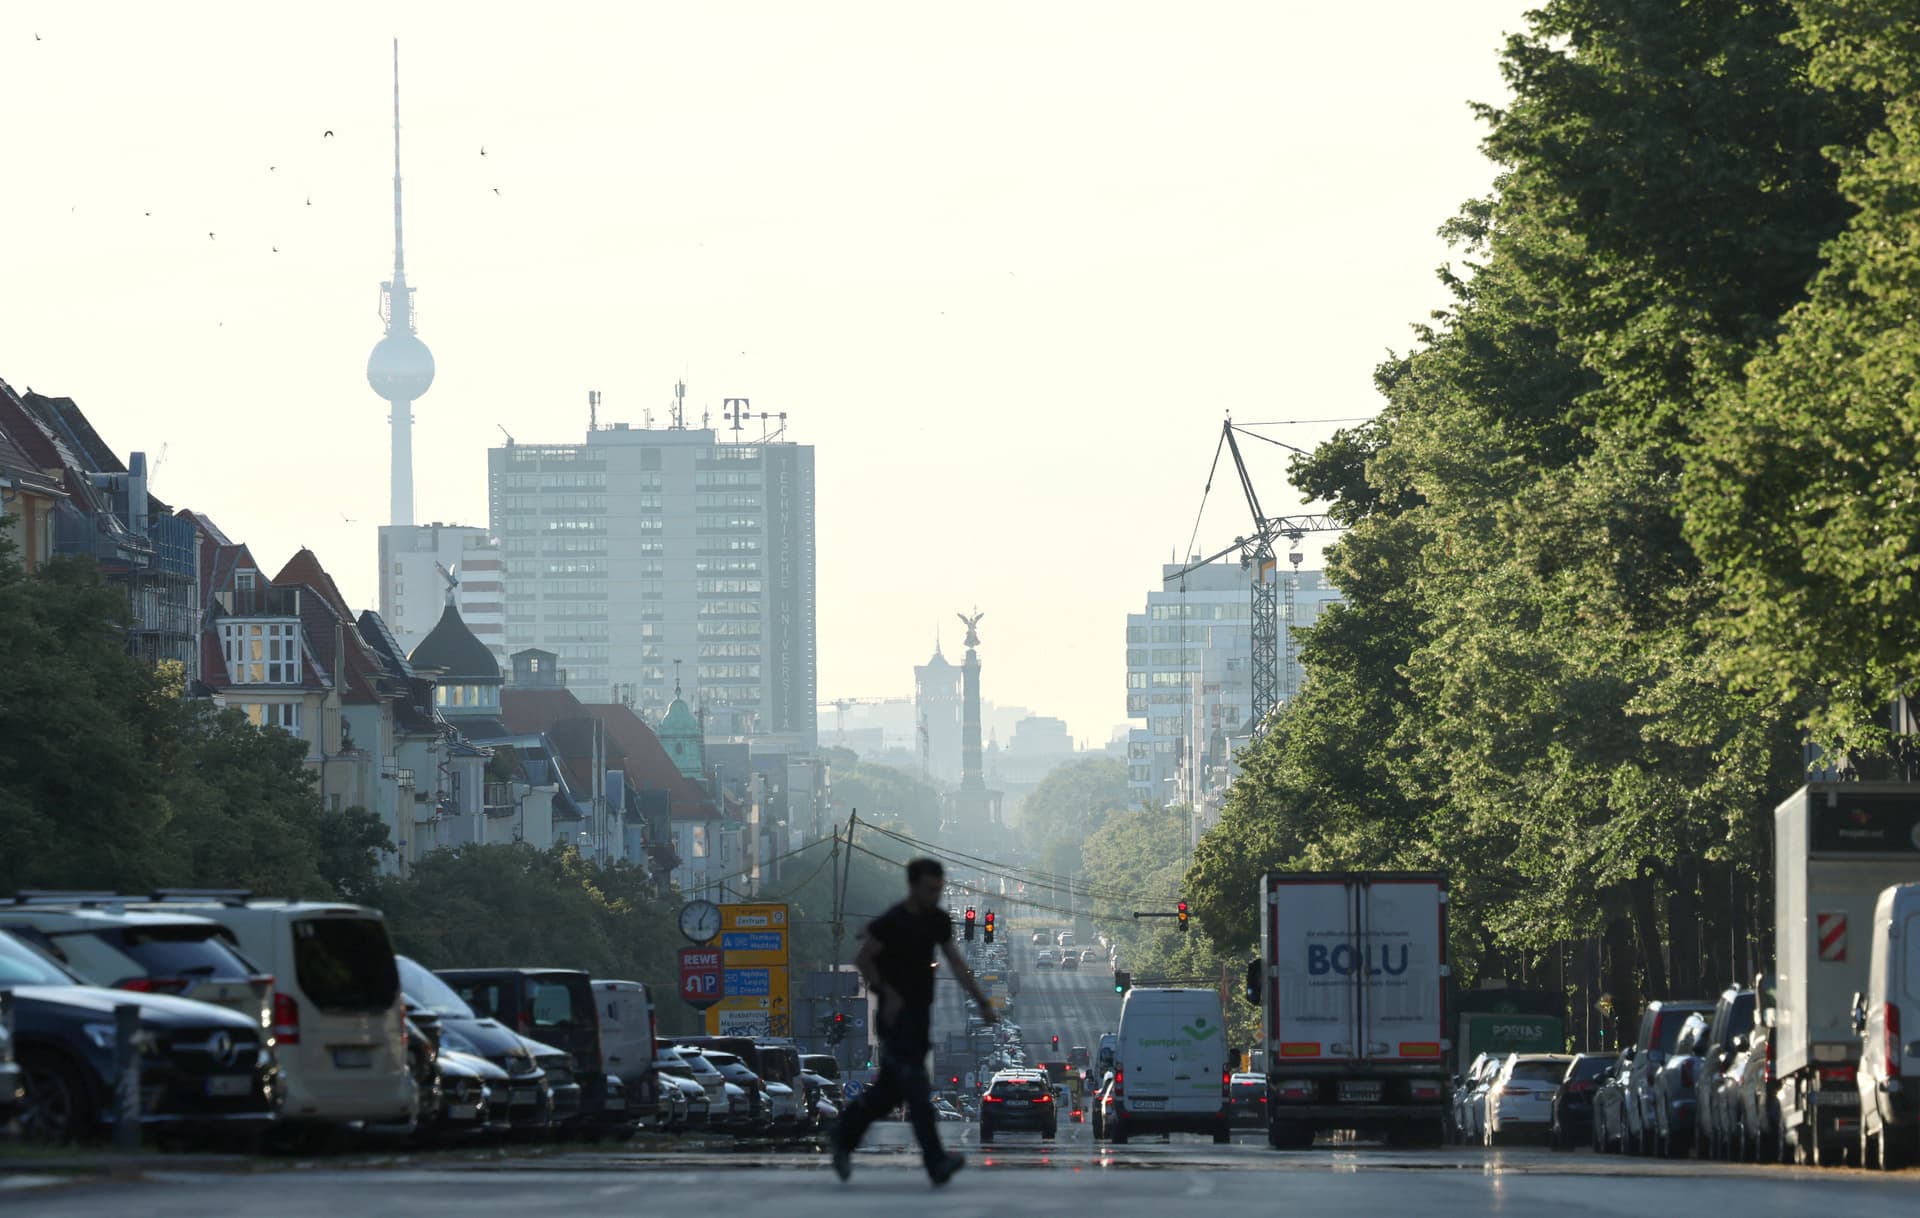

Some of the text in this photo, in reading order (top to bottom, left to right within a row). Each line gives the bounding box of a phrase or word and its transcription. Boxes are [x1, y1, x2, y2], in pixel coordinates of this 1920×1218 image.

[779, 458, 792, 588] TECHNISCHE
[684, 954, 718, 965] REWE
[1308, 943, 1408, 976] BOLU
[705, 975, 716, 991] P
